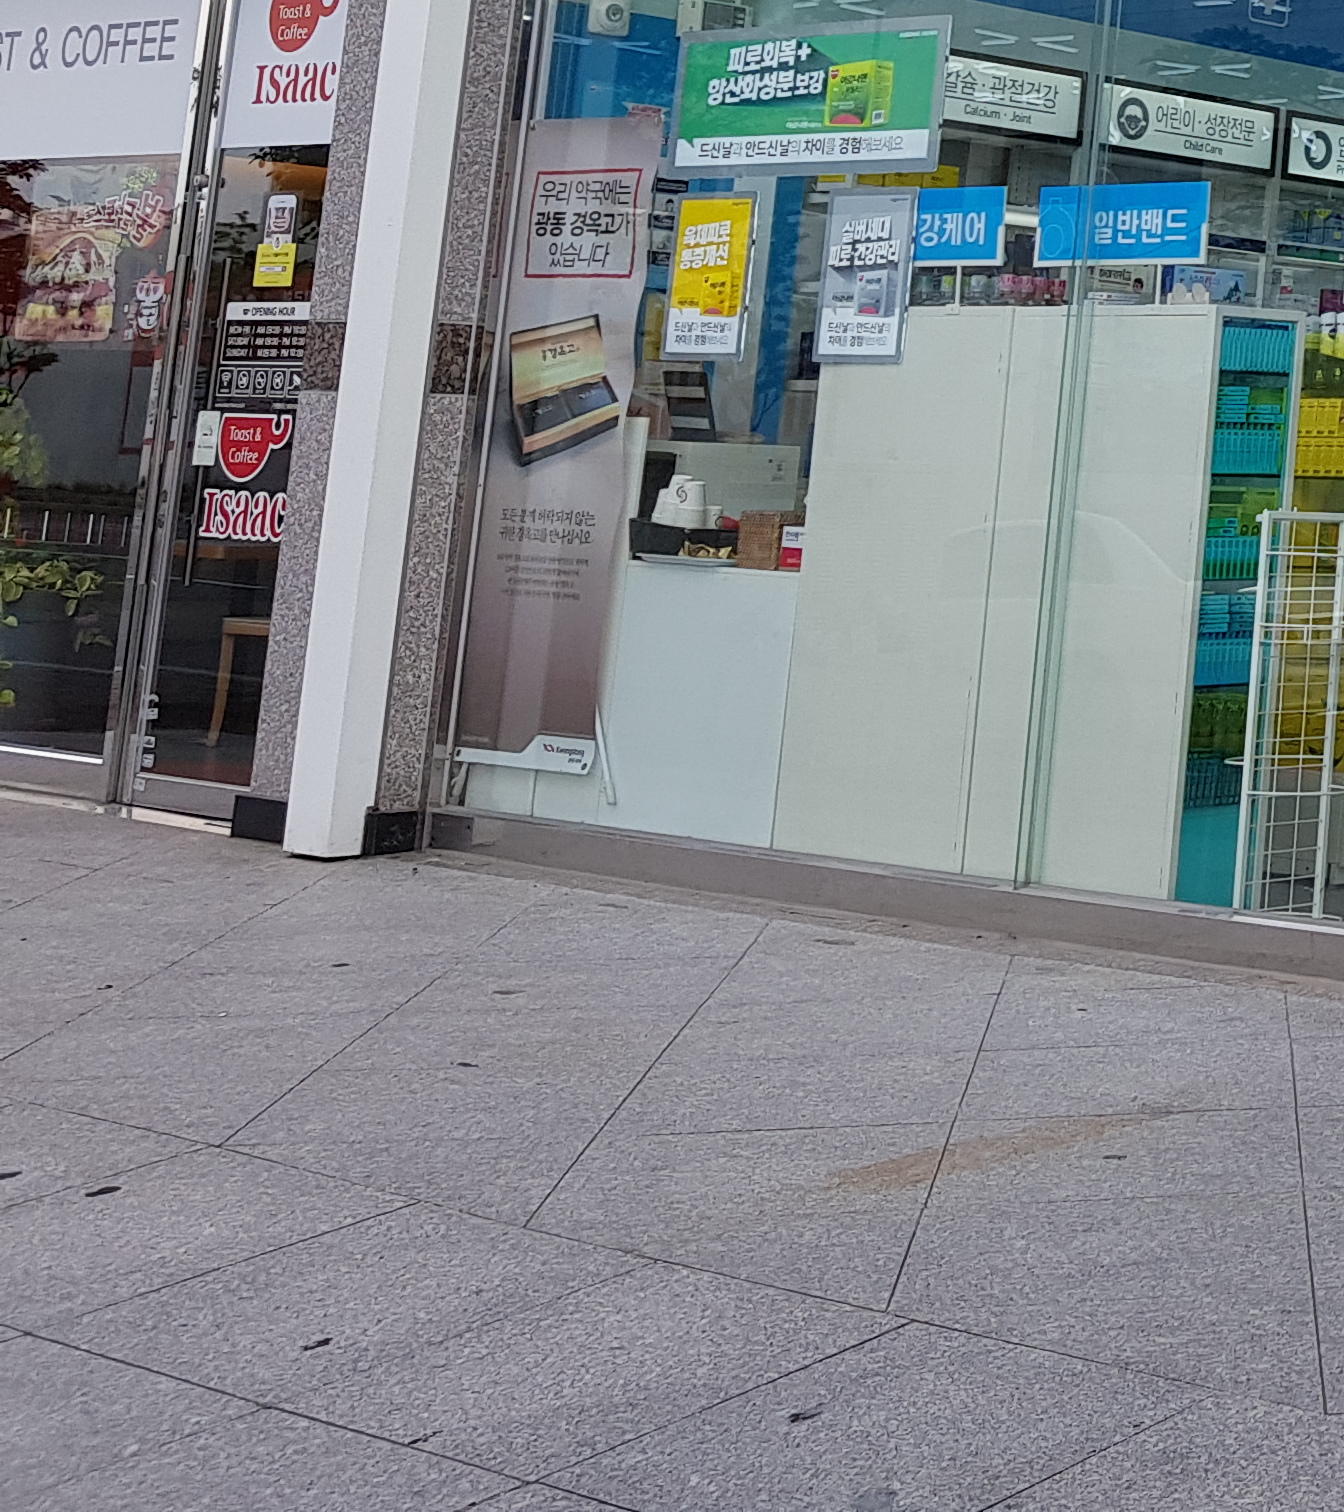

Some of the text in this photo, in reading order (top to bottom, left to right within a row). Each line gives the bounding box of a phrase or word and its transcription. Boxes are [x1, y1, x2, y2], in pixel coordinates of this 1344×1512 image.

[278, 3, 312, 21] Toast &
[29, 26, 50, 71] &
[61, 18, 180, 68] COFFEE
[277, 24, 309, 42] Coffee
[706, 69, 825, 106] 항산화성분 보강
[963, 103, 1032, 125] Calcium Joint
[1183, 139, 1224, 156] Child Care
[539, 179, 632, 206] 우리 약국에는
[534, 210, 631, 237] 광동 경옥고가
[841, 215, 893, 246] 실버세대
[1093, 208, 1188, 245] 일반밴드
[548, 241, 610, 268] 있습니다
[229, 425, 262, 441] Toast &
[228, 447, 259, 463] Coffee
